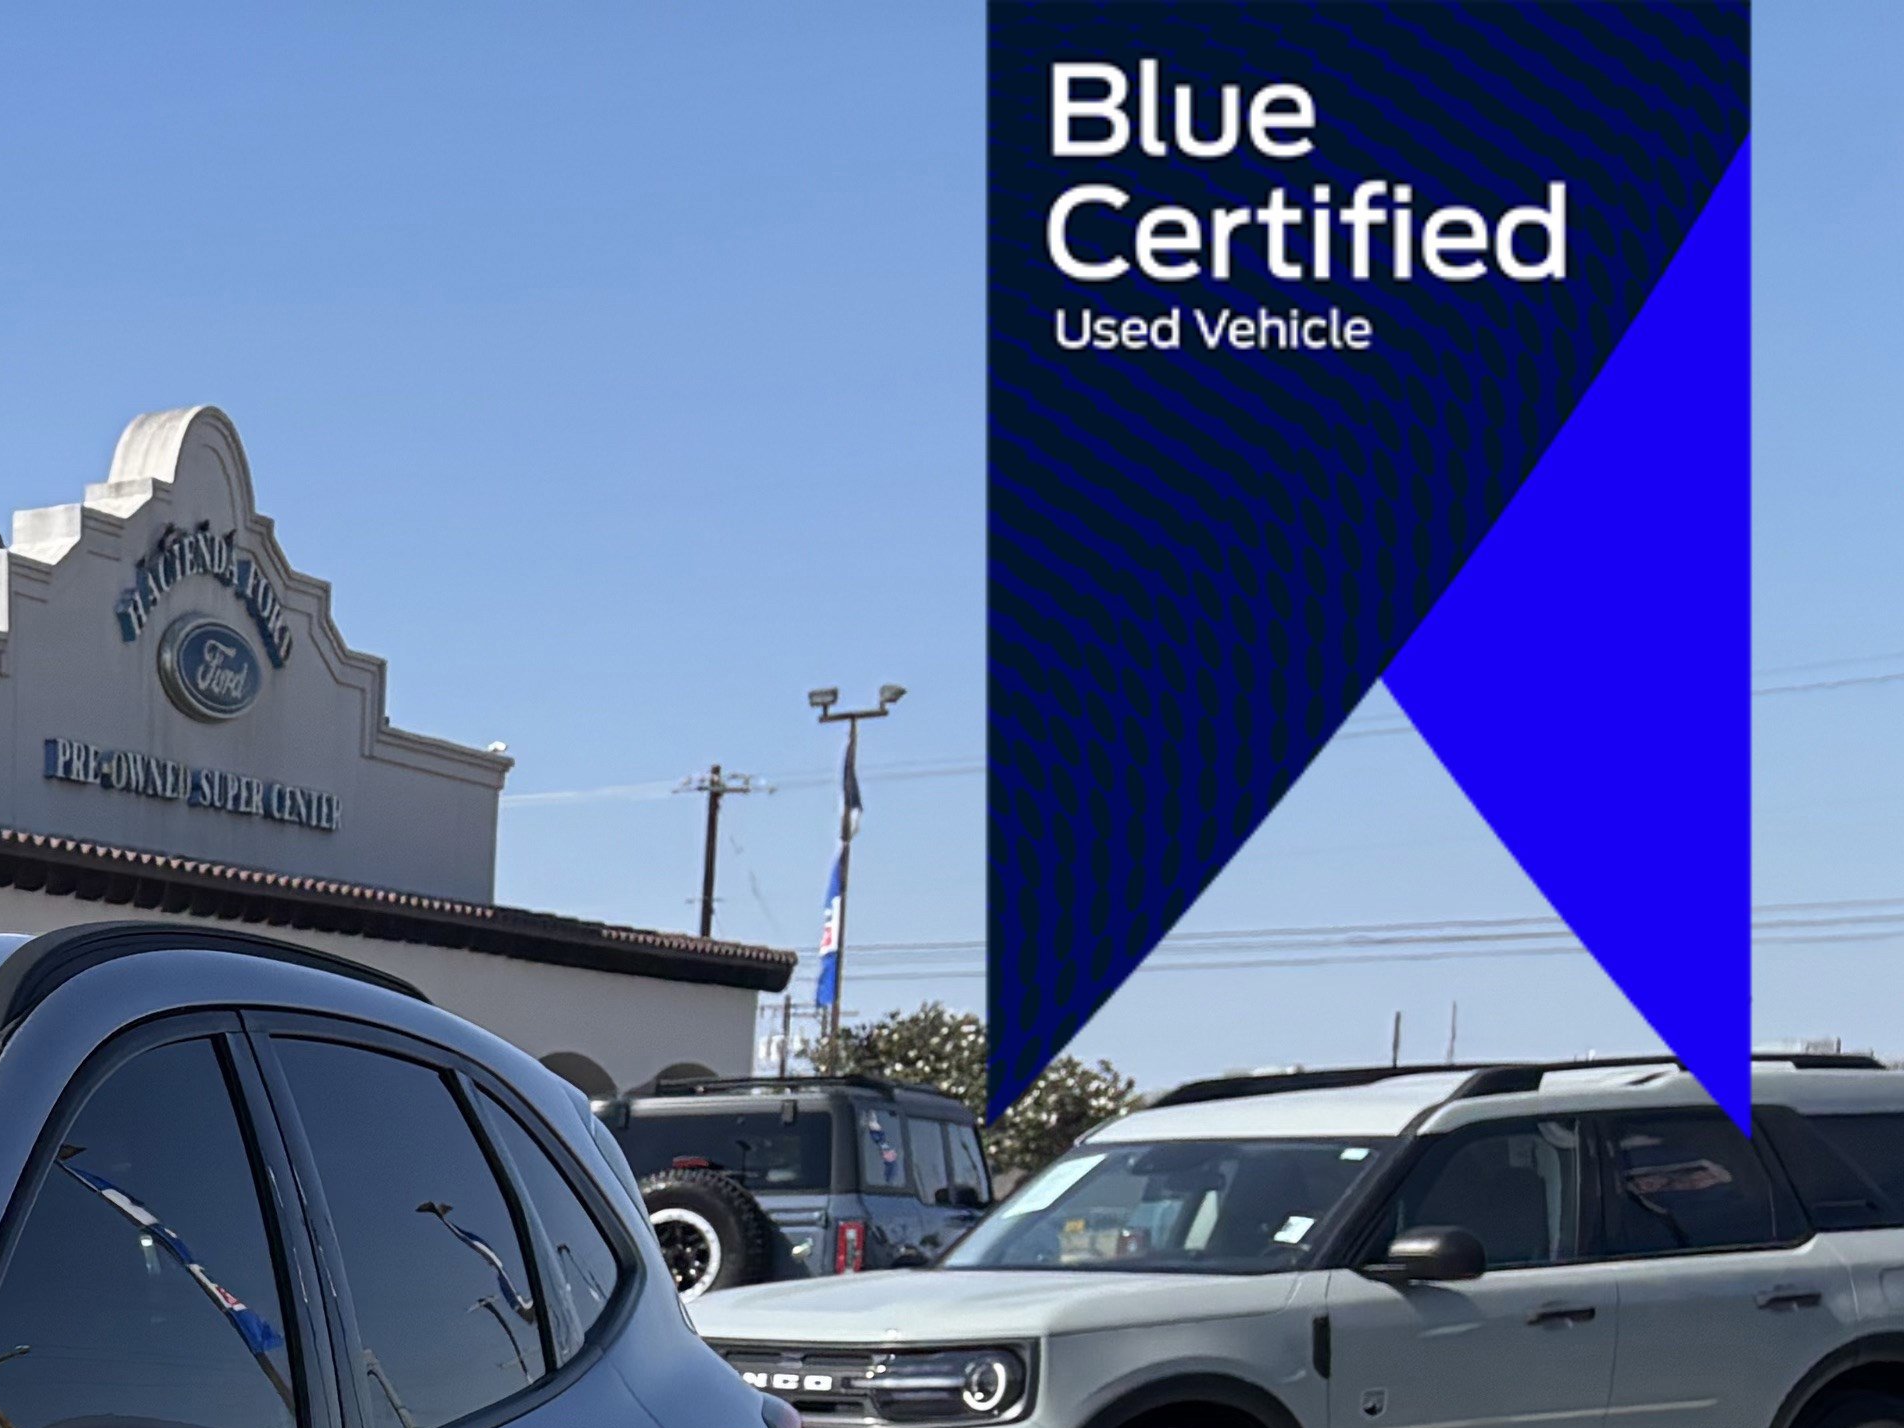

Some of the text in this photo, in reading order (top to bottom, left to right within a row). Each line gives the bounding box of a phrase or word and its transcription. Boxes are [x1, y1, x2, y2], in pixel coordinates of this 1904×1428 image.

[120, 530, 239, 638] HACIENDA
[196, 639, 249, 698] Ford
[51, 738, 342, 830] PRE-OWNED SUPER CENTER
